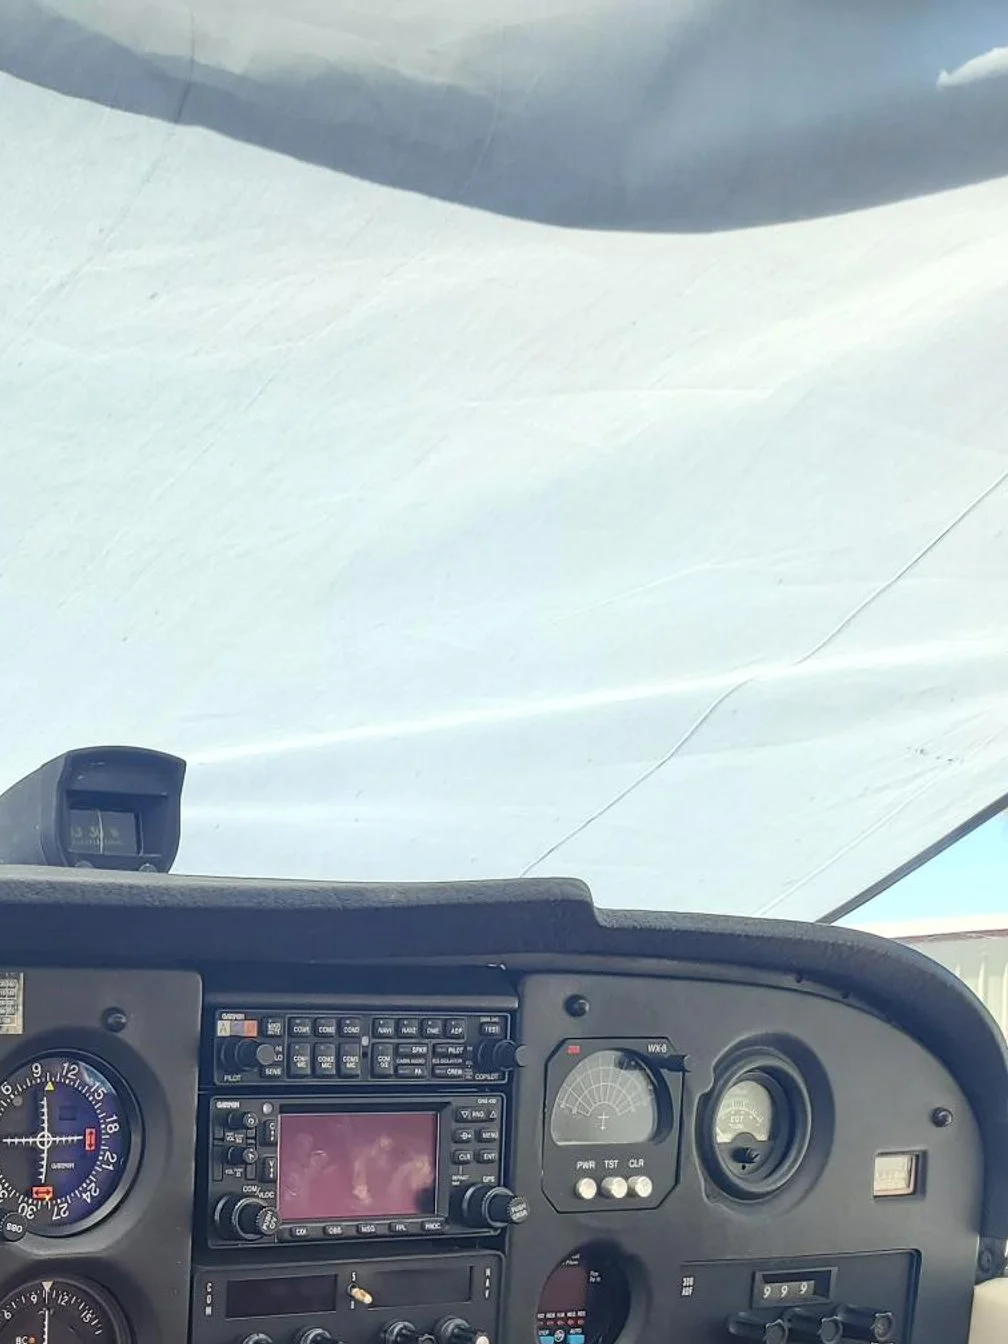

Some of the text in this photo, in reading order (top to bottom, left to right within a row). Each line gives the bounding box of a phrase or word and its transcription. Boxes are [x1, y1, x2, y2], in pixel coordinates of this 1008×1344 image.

[483, 1130, 498, 1138] MENU
[577, 1161, 595, 1170] PWR
[604, 1160, 619, 1169] TST
[629, 1159, 644, 1168] CLR
[764, 1283, 807, 1298] 9 9 9
